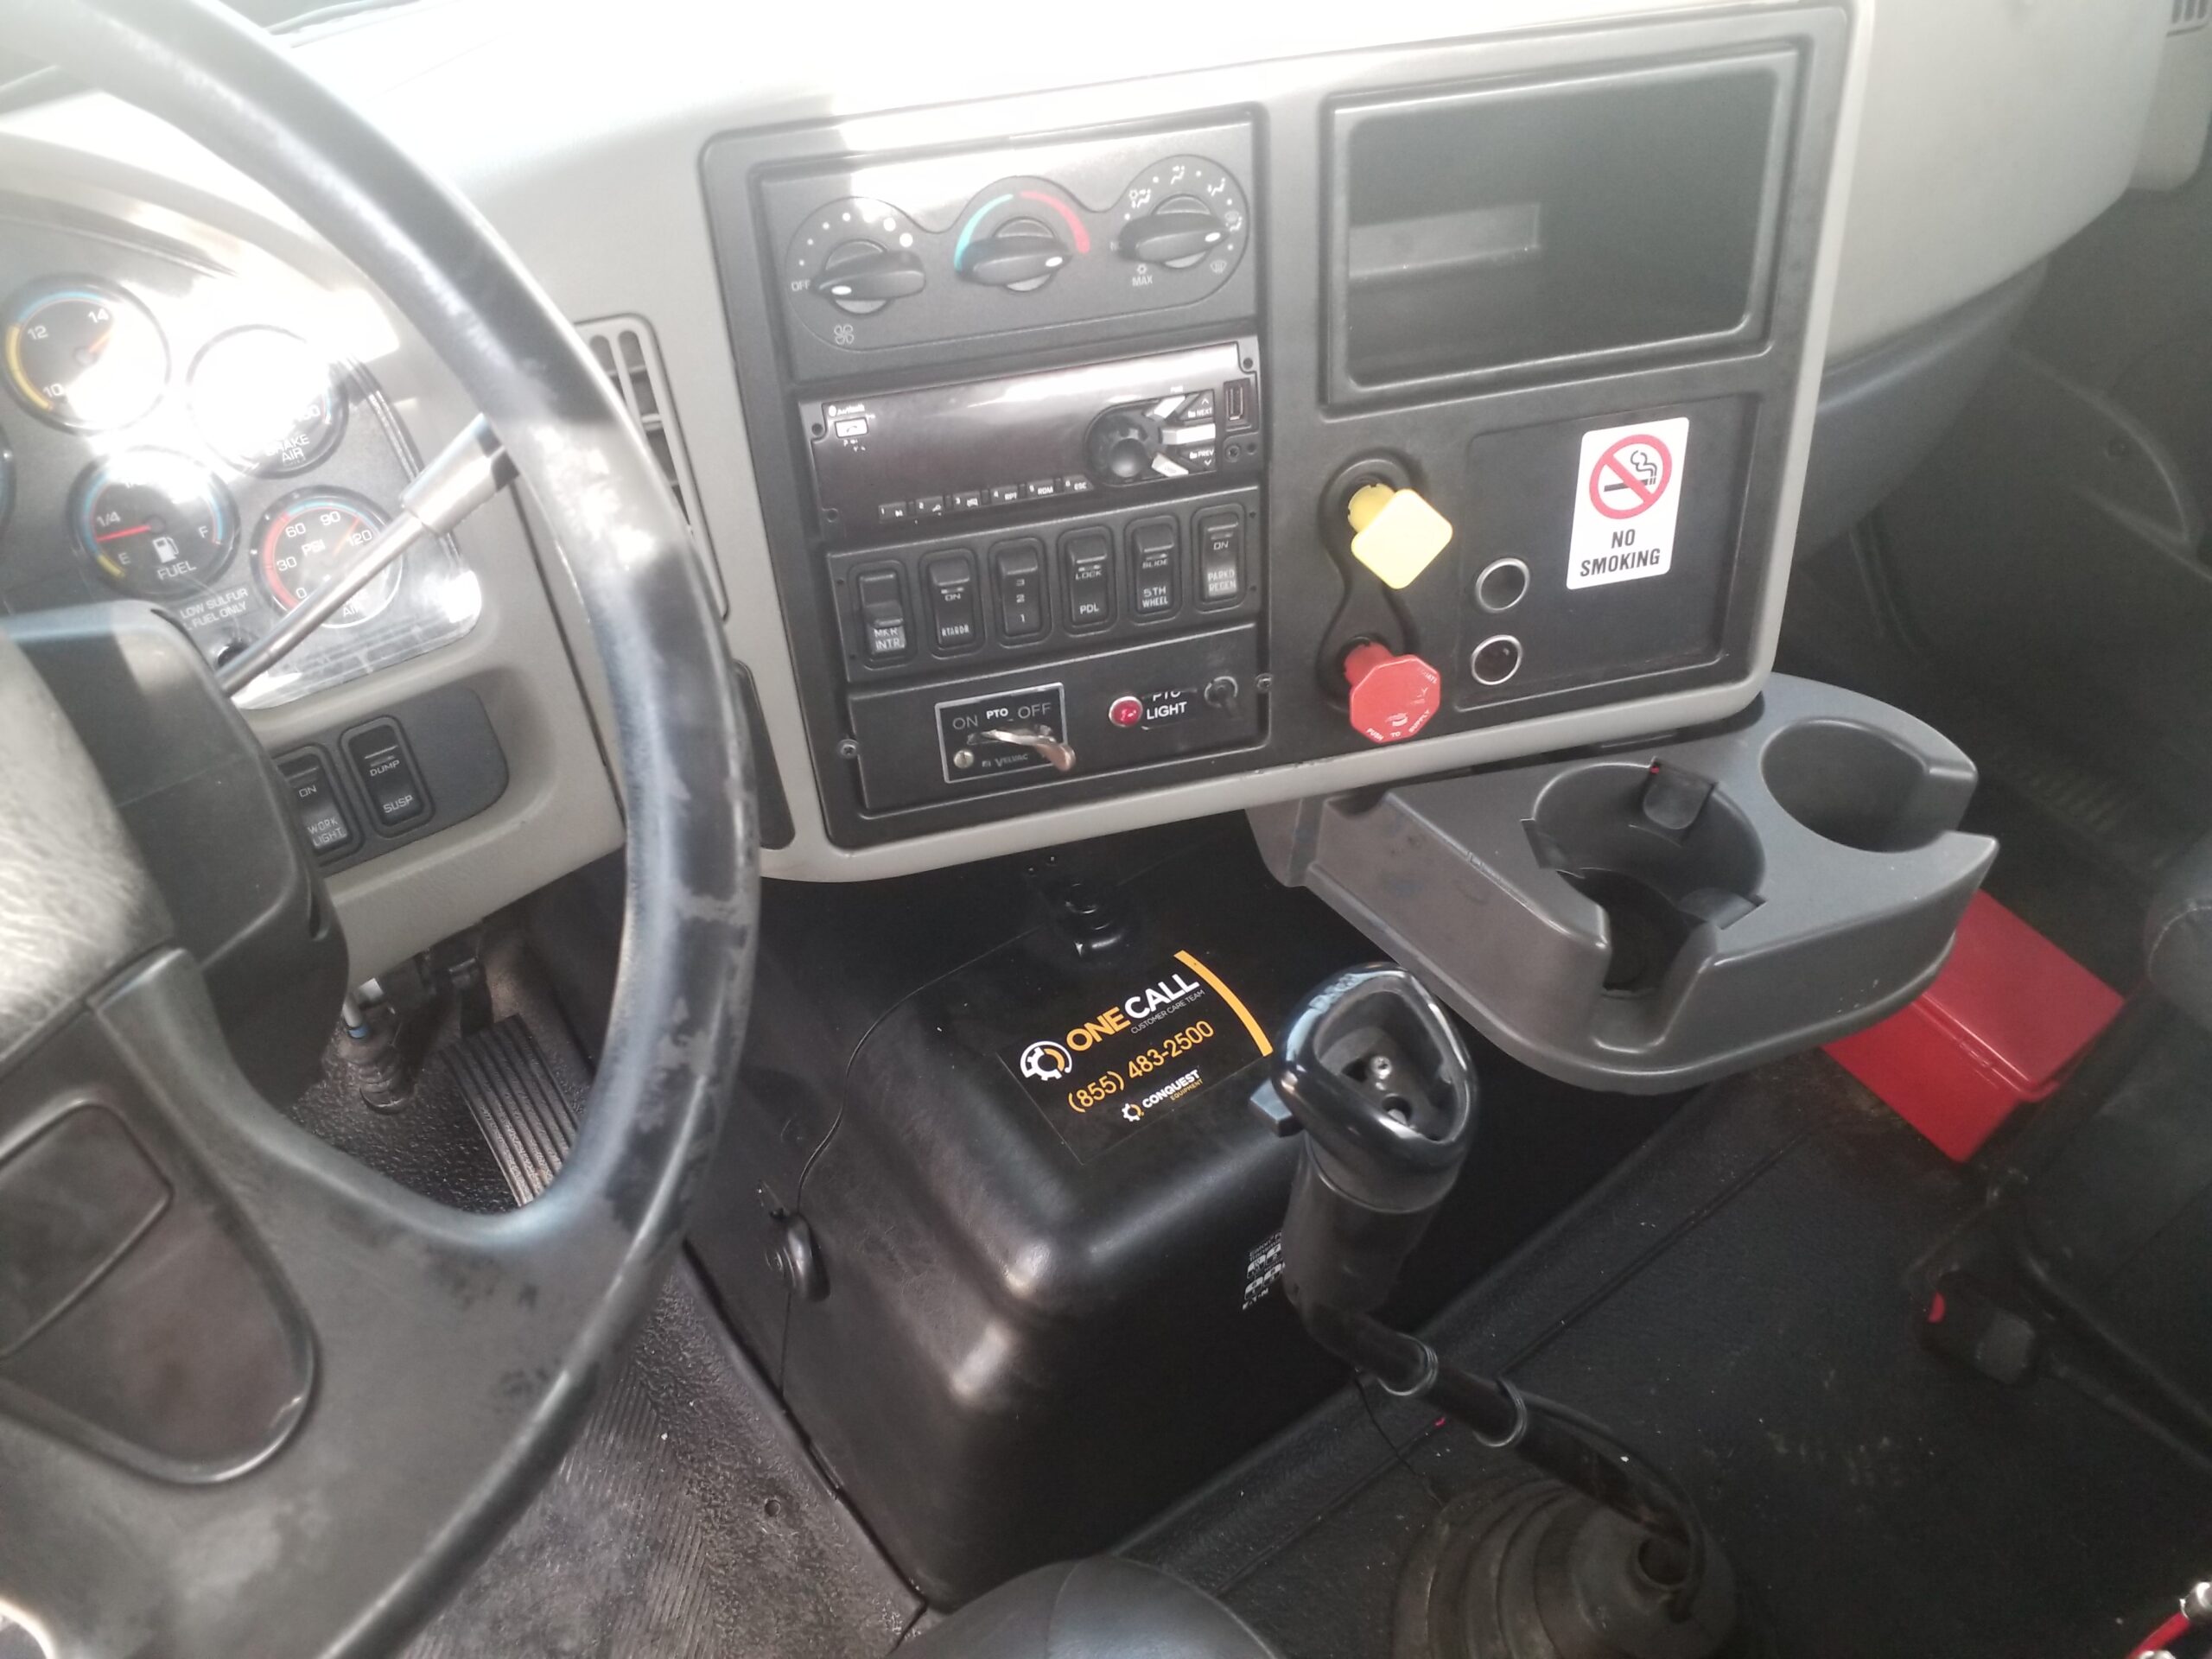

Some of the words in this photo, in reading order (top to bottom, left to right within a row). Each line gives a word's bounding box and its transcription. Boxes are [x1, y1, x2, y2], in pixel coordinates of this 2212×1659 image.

[1132, 275, 1153, 287] MAX
[88, 308, 110, 324] 14
[28, 325, 48, 341] 12
[43, 383, 65, 398] 10
[1197, 407, 1212, 416] NEXT
[283, 448, 305, 463] AIR
[1198, 448, 1214, 457] PREV
[1005, 493, 1017, 501] RPT
[1038, 486, 1054, 495] RDM
[97, 512, 121, 527] 1/4
[321, 511, 340, 525] 90
[198, 525, 208, 538] F
[286, 523, 306, 537] 60
[349, 530, 372, 546] 120
[1213, 541, 1229, 550] ON
[1611, 528, 1636, 550] NO
[302, 539, 325, 556] PSI
[118, 552, 130, 565] E
[276, 556, 297, 571] 30
[1580, 548, 1661, 577] SMOKING
[157, 561, 196, 581] FUEL
[1075, 569, 1103, 581] LOCK
[296, 588, 307, 599] 0
[1016, 594, 1025, 603] 2
[1142, 587, 1166, 598] 5TH
[180, 603, 204, 619] LOW
[206, 588, 248, 609] SULFUR
[1079, 604, 1100, 615] PDL
[1141, 596, 1168, 608] WHEEL
[192, 613, 219, 627] FUEL
[219, 601, 246, 618] ONLY
[874, 626, 899, 638] MKR
[986, 708, 1008, 720] PTO
[1018, 702, 1052, 719] OFF
[1146, 702, 1187, 720] LIGHT
[952, 715, 978, 730] ON
[1366, 728, 1384, 741] PUSH
[1408, 709, 1430, 733] SUPPLY
[370, 760, 400, 777] DUMP
[299, 785, 318, 798] ON
[383, 794, 414, 813] SUSP
[308, 817, 339, 834] WORK
[313, 828, 345, 847] LIGHT
[1130, 1009, 1167, 1034] CUSTOMER
[1166, 999, 1185, 1015] CARE
[1184, 989, 1206, 1005] TEAM
[1068, 1071, 1125, 1113] (855)
[1128, 1020, 1214, 1079] 483-2500
[1141, 1069, 1201, 1109] CONQUEST
[1170, 1079, 1204, 1102] EQUIPMENT
